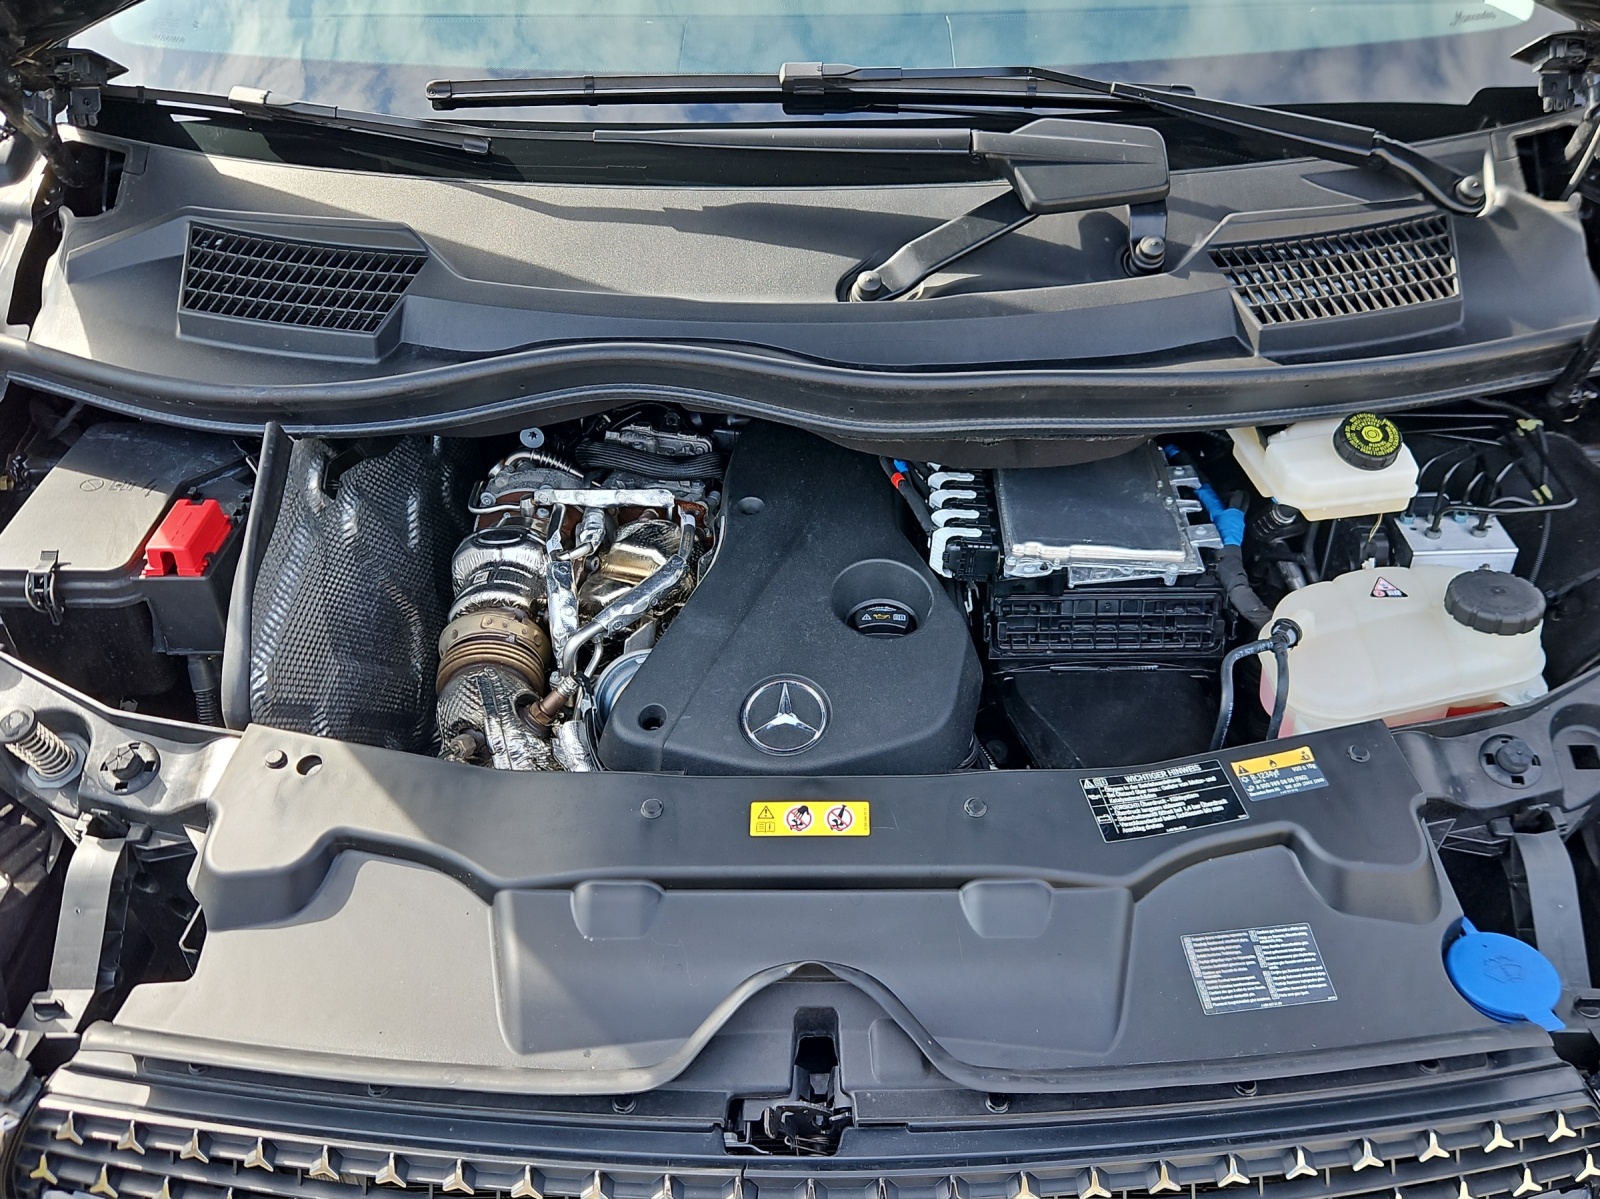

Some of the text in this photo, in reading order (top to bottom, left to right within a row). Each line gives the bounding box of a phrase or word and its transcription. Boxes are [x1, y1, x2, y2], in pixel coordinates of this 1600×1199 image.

[1124, 765, 1203, 783] WICHTIGER HINWEIS
[1250, 769, 1281, 783] R-1234yf
